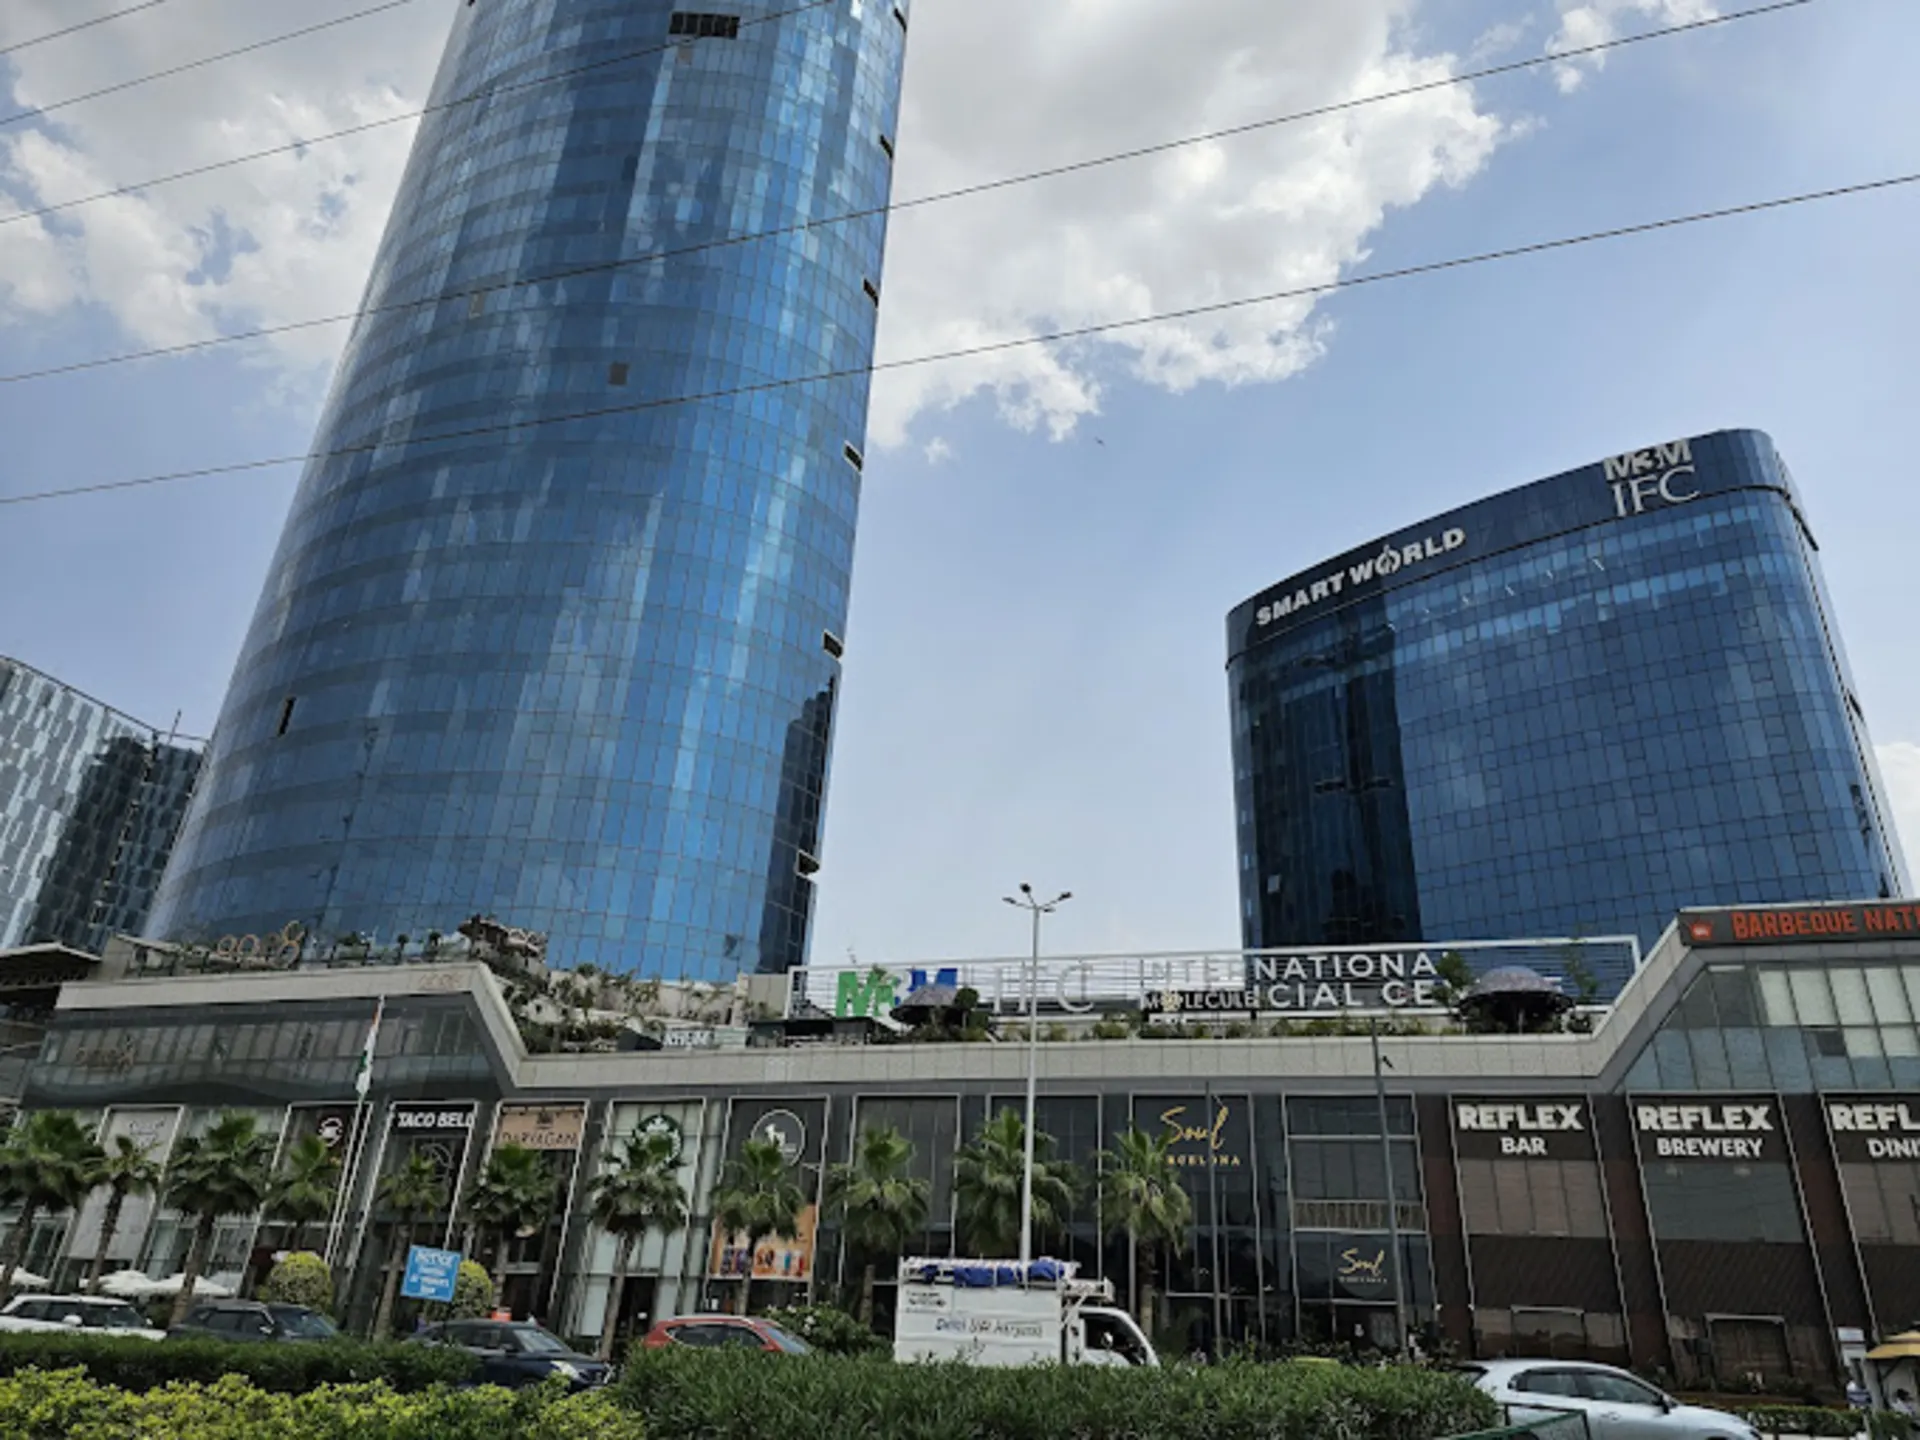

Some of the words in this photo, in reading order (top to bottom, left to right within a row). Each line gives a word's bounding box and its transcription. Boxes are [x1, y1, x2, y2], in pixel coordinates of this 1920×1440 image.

[1612, 464, 1701, 517] IFC
[1256, 570, 1346, 626] SMART
[1349, 527, 1466, 585] WORLD
[1731, 909, 1859, 940] BARBEQUE
[398, 1112, 436, 1128] TACO
[1457, 1104, 1585, 1130] REFLEX
[1637, 1104, 1774, 1131] REFLEX
[1501, 1136, 1548, 1156] BAR
[1656, 1137, 1764, 1158] BREWERY
